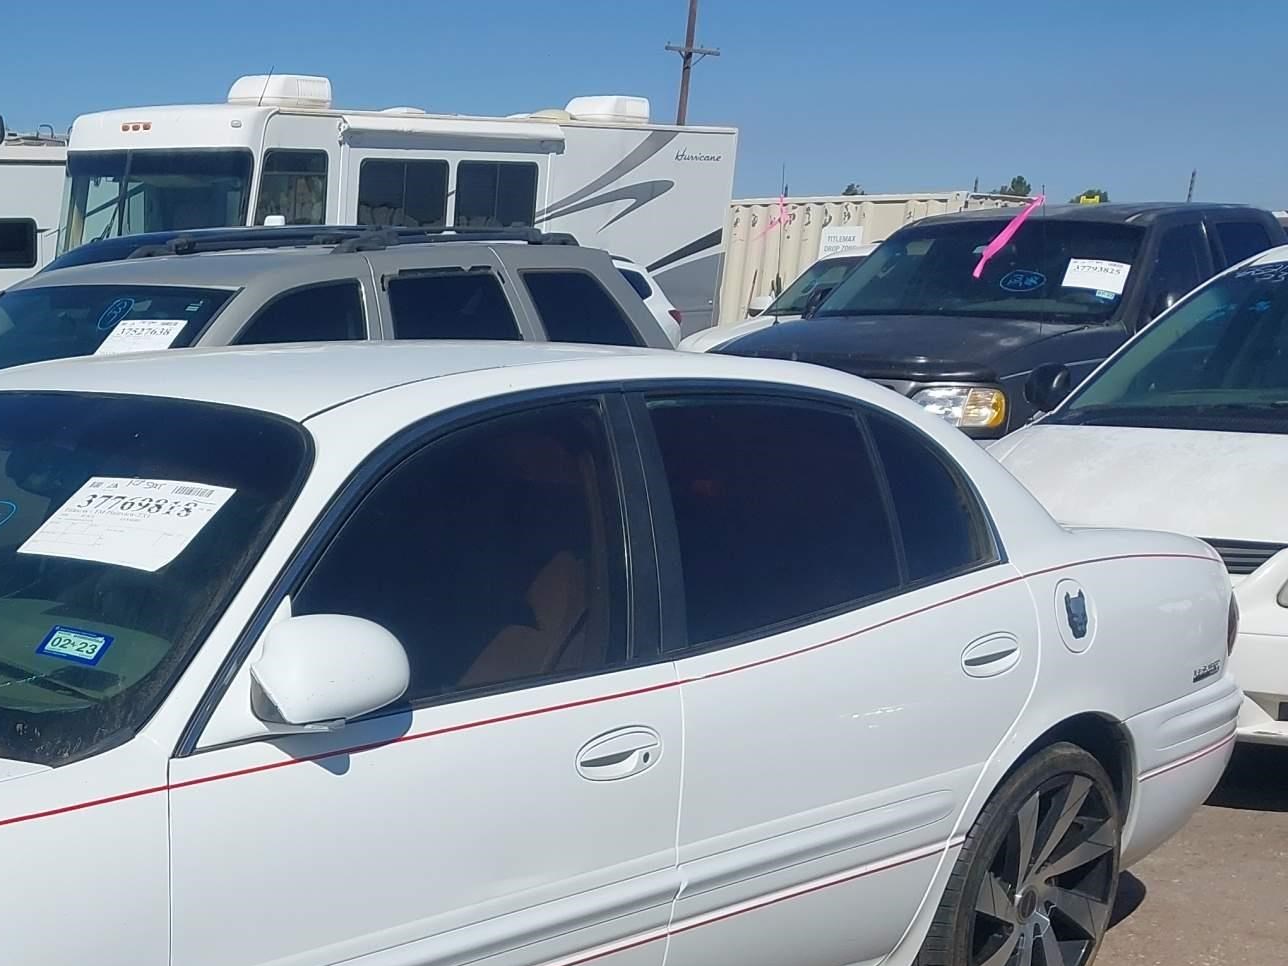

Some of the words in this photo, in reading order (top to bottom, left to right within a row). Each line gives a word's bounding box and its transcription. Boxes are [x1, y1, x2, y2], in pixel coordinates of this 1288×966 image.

[674, 147, 722, 161] Hurricane
[827, 235, 857, 243] TITLEMAX
[77, 494, 198, 517] 37769818
